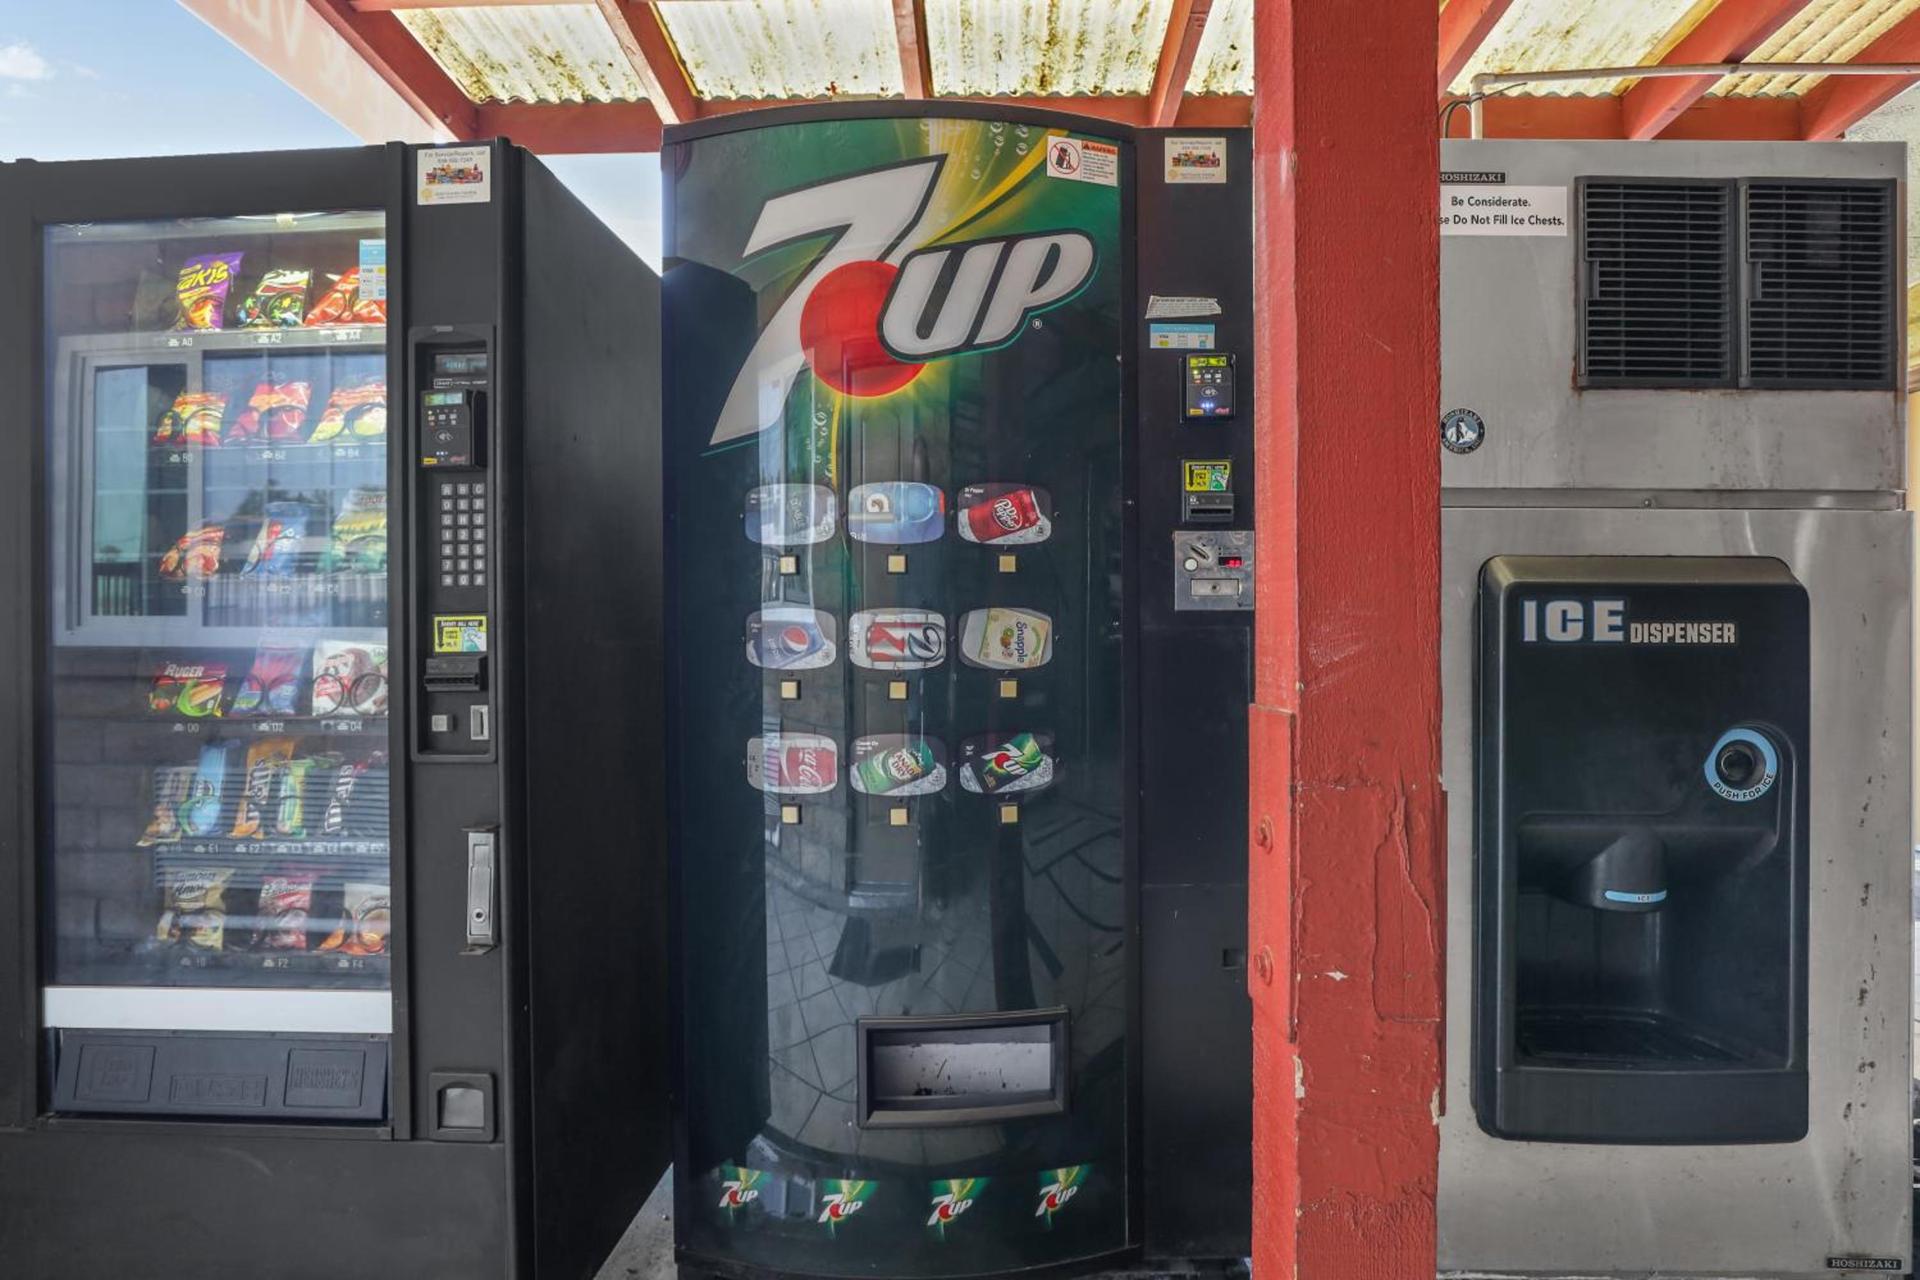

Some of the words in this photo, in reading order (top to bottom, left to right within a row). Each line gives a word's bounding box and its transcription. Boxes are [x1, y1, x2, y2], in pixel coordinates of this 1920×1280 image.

[1451, 196, 1464, 207] Be
[1467, 196, 1531, 207] Considerate.
[1453, 214, 1468, 225] Do
[1470, 214, 1490, 225] Not
[1493, 214, 1507, 225] Fill
[1511, 214, 1525, 225] Ice
[1527, 214, 1565, 226] Chests.
[1523, 600, 1625, 642] ICE
[1630, 623, 1736, 643] DISPENSER
[1015, 621, 1028, 663] Snapple
[1713, 782, 1739, 799] PUSH
[1742, 787, 1762, 799] FOR
[1763, 773, 1774, 788] ICE
[718, 1180, 759, 1207] 7UP
[1035, 1184, 1078, 1217] 7UP
[818, 1193, 863, 1225] 7UP
[927, 1194, 973, 1226] 7UP
[1831, 1259, 1898, 1269] HOSHIZAKI
